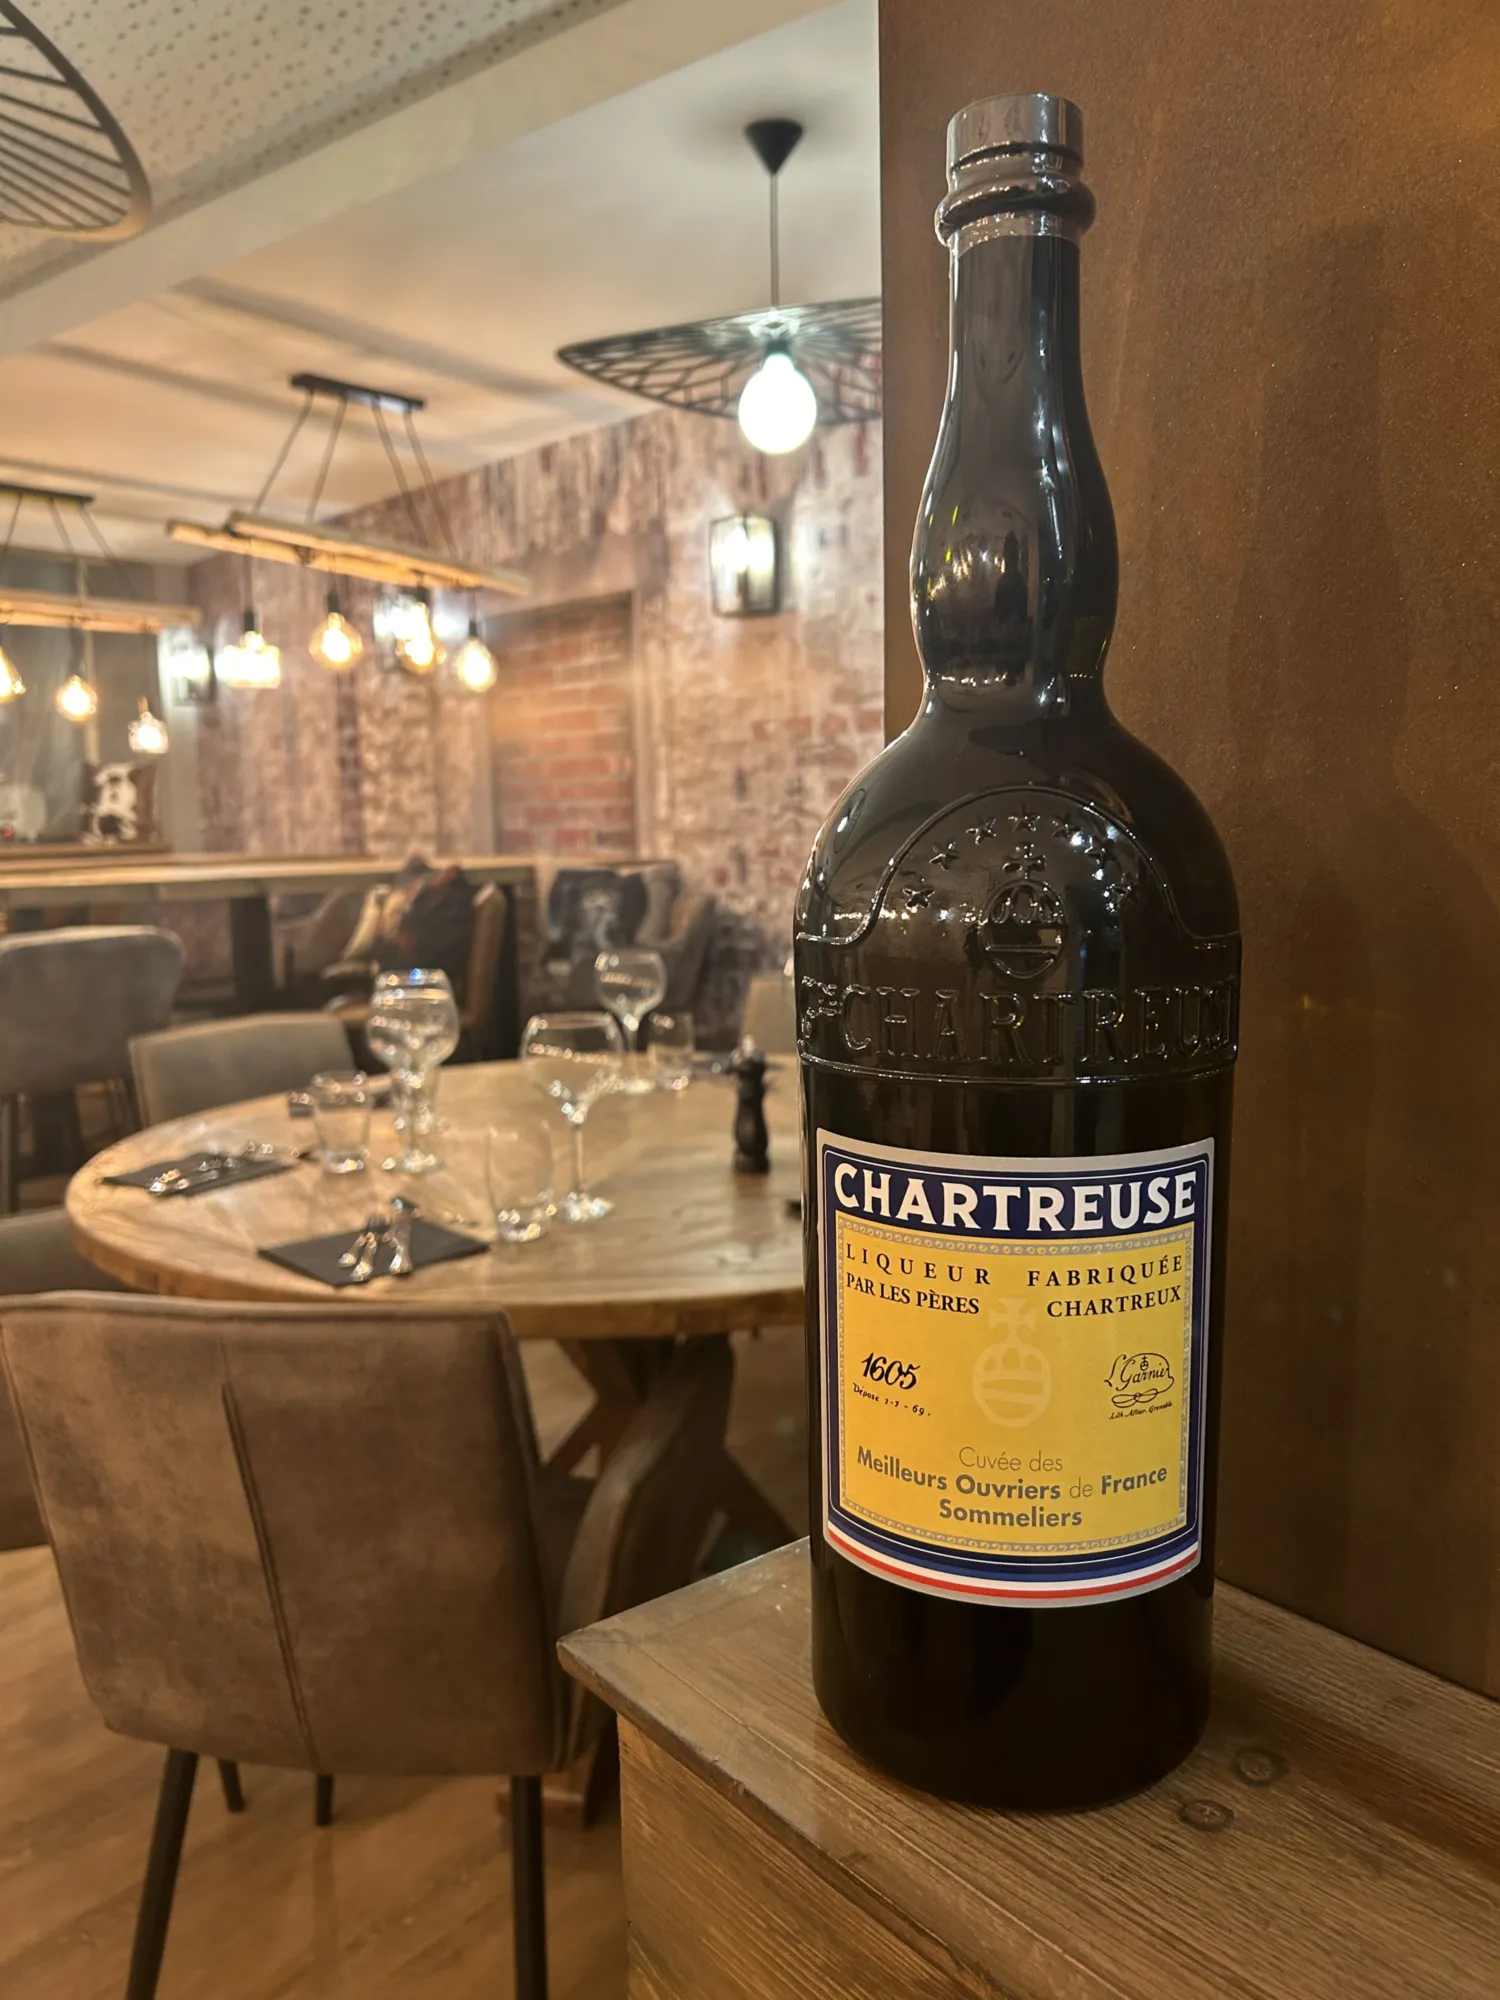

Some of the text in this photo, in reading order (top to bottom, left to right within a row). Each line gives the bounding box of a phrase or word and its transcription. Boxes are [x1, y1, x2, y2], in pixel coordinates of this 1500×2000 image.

[833, 1162, 1197, 1232] CHARTREUSE
[846, 1242, 1183, 1287] LIQUEUR FABRIQUÉE
[846, 1272, 1182, 1318] PAR LES PÈRES CHARTREUX
[861, 1352, 921, 1390] 1605
[857, 1445, 1168, 1500] Meilleurs Ouvriers de France
[959, 1446, 1063, 1473] Cuvée des
[939, 1498, 1083, 1528] Sommeliers
